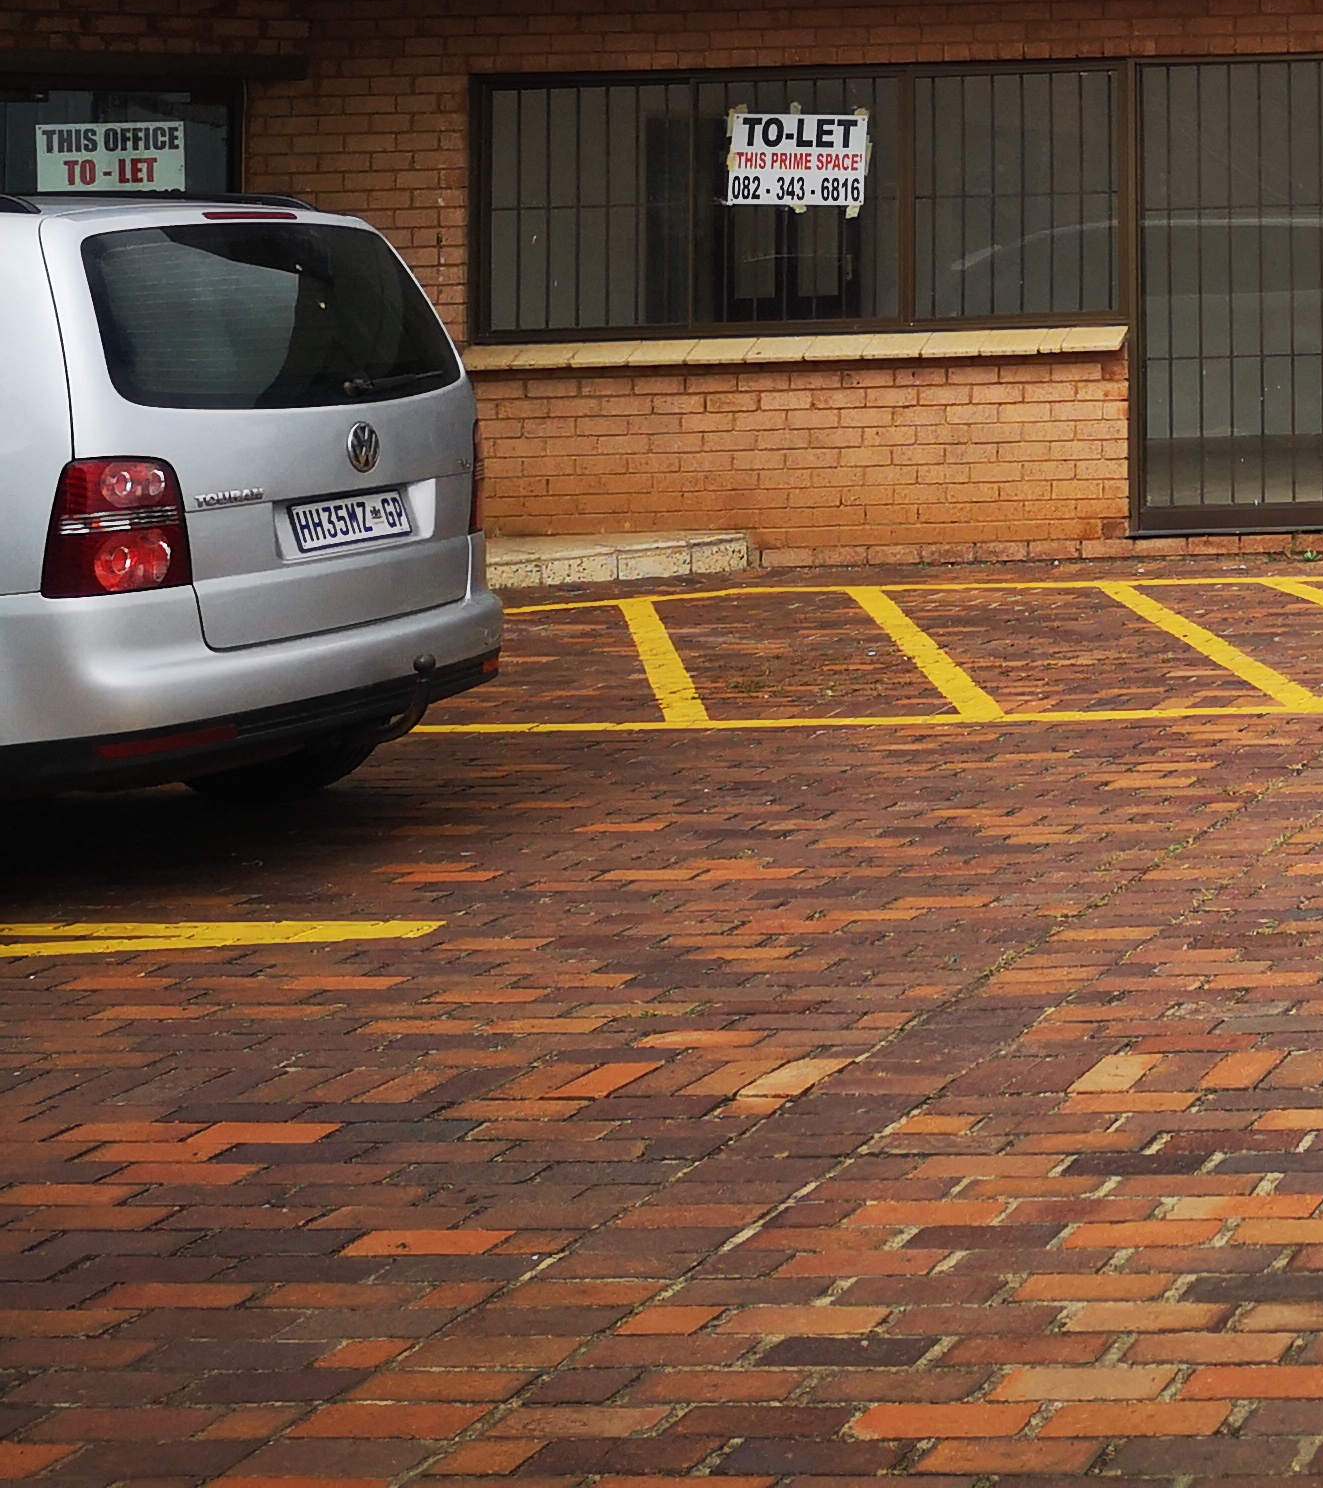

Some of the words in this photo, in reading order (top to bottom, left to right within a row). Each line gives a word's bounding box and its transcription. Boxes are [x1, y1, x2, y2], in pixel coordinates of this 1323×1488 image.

[42, 128, 98, 153] THIS
[104, 126, 180, 152] OFFICE
[742, 117, 858, 148] TO-LET
[64, 159, 97, 186] TO
[118, 157, 158, 184] LET
[771, 153, 812, 170] PRIME
[732, 175, 761, 200] 082
[776, 176, 805, 201] 343
[821, 177, 861, 202] 6816
[194, 487, 265, 509] TOURAN
[295, 502, 374, 543] HH35MZ
[381, 496, 403, 528] GP
